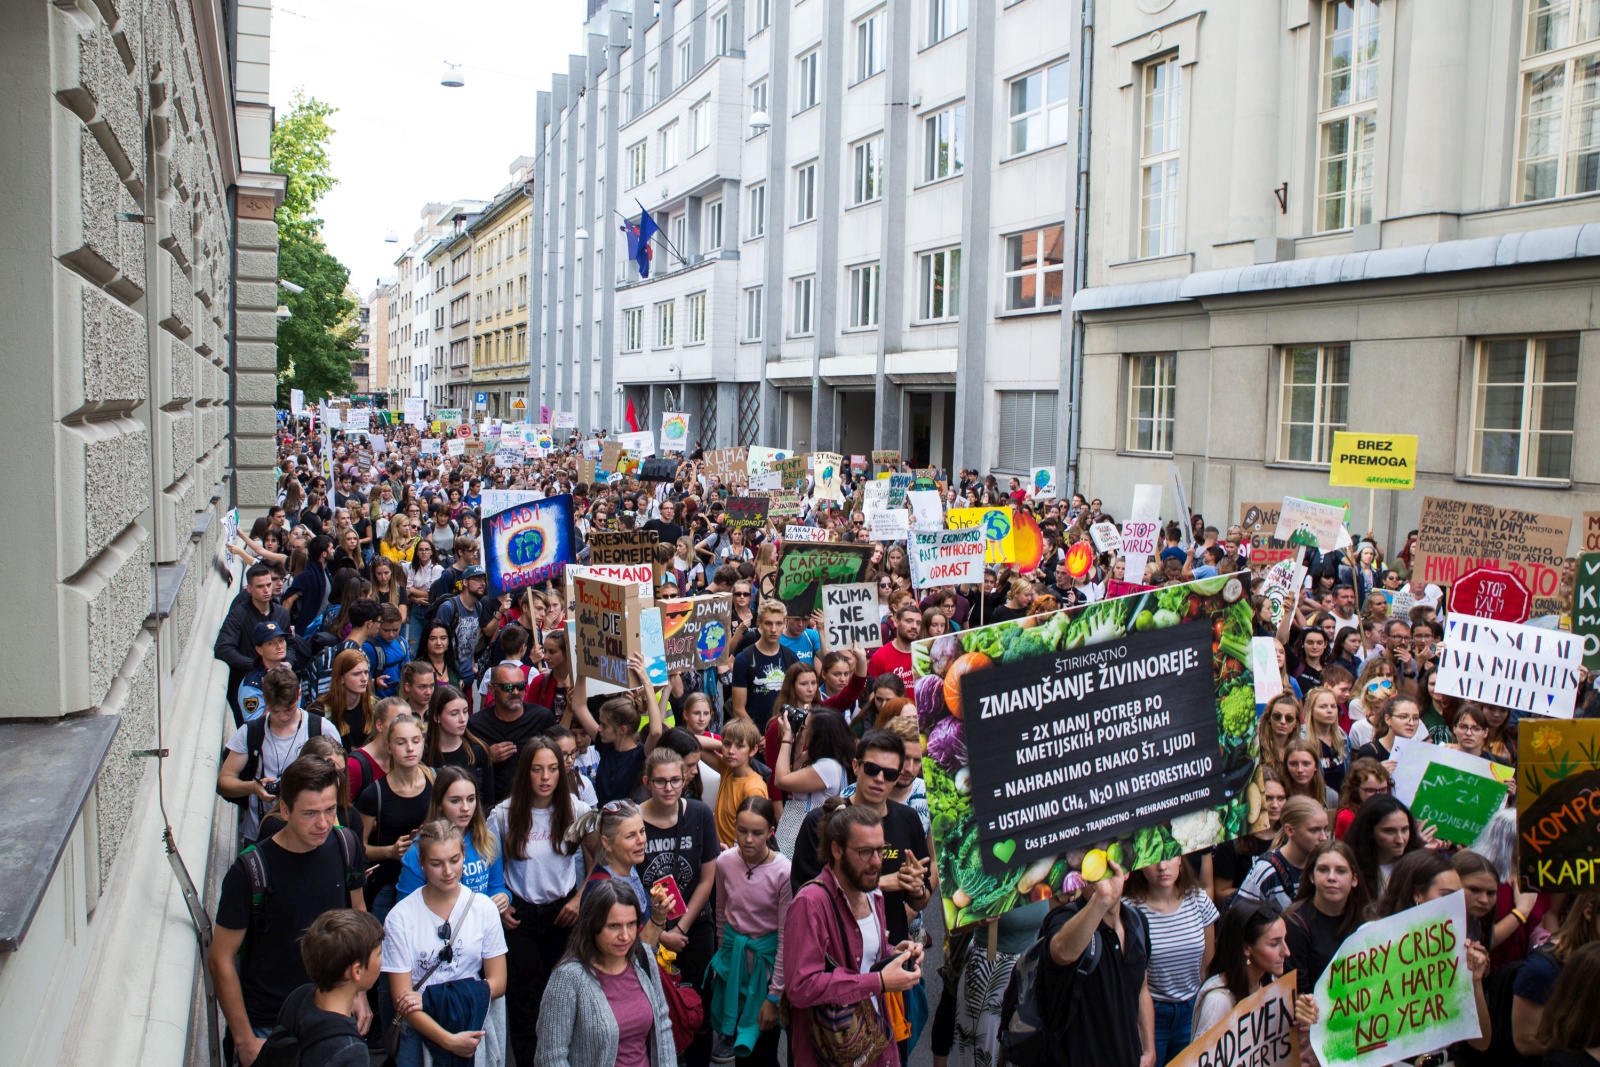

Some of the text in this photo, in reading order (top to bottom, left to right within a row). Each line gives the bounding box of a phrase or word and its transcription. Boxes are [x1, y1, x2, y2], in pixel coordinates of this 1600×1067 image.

[478, 394, 485, 402] P
[1357, 440, 1393, 451] BREZ
[704, 448, 745, 467] KLIMA
[1340, 454, 1408, 467] PREMOGA
[717, 463, 732, 472] NE
[1366, 476, 1411, 485] GREENPEACE
[490, 503, 540, 537] MLADI
[1427, 500, 1432, 509] V
[1500, 509, 1507, 518] V
[1509, 511, 1539, 525] ZRAK
[726, 518, 766, 527] PRIHODNOST
[1124, 522, 1156, 538] STOP
[1500, 520, 1524, 537] DIM,
[1524, 525, 1553, 533] NAMESTO
[1122, 539, 1153, 554] VIRUS
[1419, 534, 1449, 543] ČAKAMO
[1508, 543, 1553, 556] DOBIMO
[1491, 532, 1526, 543] SAMO
[940, 546, 952, 558] MI
[953, 542, 983, 556] HOČEMO
[1252, 550, 1292, 562] DIE
[1419, 541, 1457, 555] PLJUČNEGA
[1504, 551, 1521, 562] TUDI
[1524, 554, 1564, 567] ASTMO
[790, 551, 850, 571] CARBON
[930, 562, 970, 579] ODRAST
[785, 567, 829, 587] FOOLS
[1528, 563, 1558, 596] TO
[576, 580, 622, 615] Tony Stark
[827, 589, 872, 605] KLIMA
[1478, 580, 1506, 596] STOP
[696, 601, 730, 617] DAMN,
[1475, 594, 1504, 612] PALM
[602, 612, 621, 635] DIE
[840, 606, 864, 624] NE
[684, 622, 702, 634] YOU
[828, 620, 880, 645] ŠTIMA
[580, 627, 626, 660] 4 us 2 KILL
[666, 636, 694, 655] HOT
[583, 647, 628, 684] the PLANET
[1055, 646, 1128, 674] ŠTIRIKRATNO
[980, 647, 1199, 720] ZMANJŠANJE ŽIVINOREJE:
[1032, 723, 1050, 742] 2X
[1053, 717, 1090, 738] MANJ
[1093, 700, 1142, 725] POTREB
[1145, 694, 1163, 713] PO
[1016, 711, 1171, 765] KMETIJSKIH POVRŠINAH
[1005, 760, 1092, 798] NAHRANIMO
[1095, 747, 1139, 773] ENAKO
[1142, 742, 1160, 760] ŠT.
[1163, 731, 1196, 755] LJUDI
[1422, 774, 1479, 791] MLADI
[998, 801, 1060, 830] USTAVIMO
[1115, 780, 1129, 795] IN
[1132, 756, 1213, 793] DEFORESTACIJO
[1456, 790, 1480, 806] ZA
[1025, 836, 1040, 850] ČAS
[1040, 835, 1048, 847] JE
[1048, 832, 1058, 844] ZA
[1059, 826, 1080, 842] NOVO
[1086, 812, 1130, 831] TRAJNOSTNO
[1136, 797, 1179, 818] PREHRANSKO
[1180, 787, 1210, 805] POLITIKO
[1330, 920, 1456, 989] MERRY CRISIS
[1329, 956, 1459, 1021] AND A HAPPY
[1238, 989, 1296, 1058] EVEN
[1355, 994, 1448, 1046] NO YEAR
